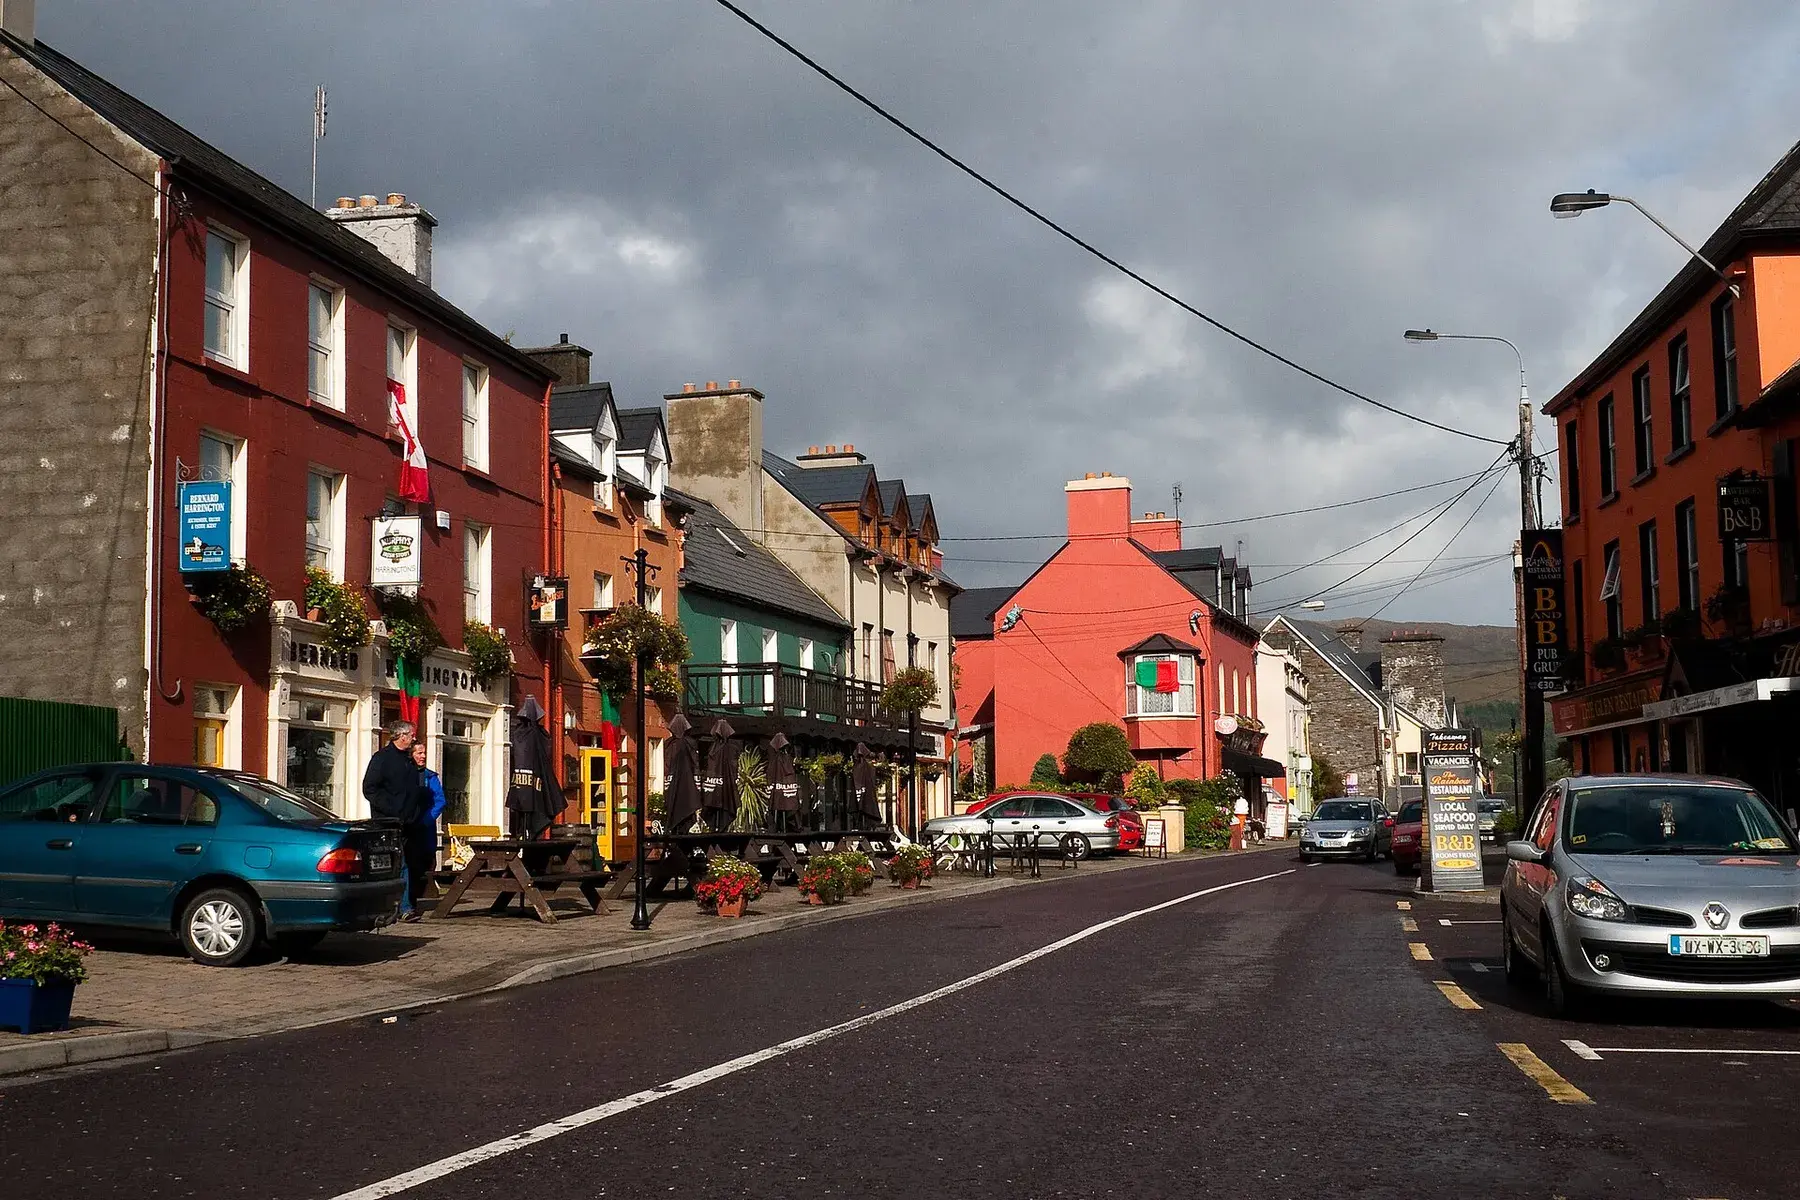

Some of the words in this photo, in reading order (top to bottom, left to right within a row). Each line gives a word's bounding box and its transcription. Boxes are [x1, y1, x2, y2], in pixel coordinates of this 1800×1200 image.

[190, 494, 219, 504] BERNARD
[184, 503, 225, 513] HARRINGTON
[1722, 507, 1762, 531] B&B
[1533, 587, 1557, 611] B
[1534, 620, 1558, 645] B
[1537, 648, 1558, 660] PUB
[1537, 681, 1554, 690] €30
[1430, 732, 1467, 741] Takeaway
[1428, 741, 1469, 750] Pizzas
[1428, 757, 1470, 765] VACANCIES
[1443, 770, 1457, 778] The
[1431, 776, 1471, 785] Rainbow
[1430, 786, 1473, 794] RESTAURANT
[1440, 802, 1467, 811] LOCAL
[1433, 812, 1476, 823] SEAFOOD
[1435, 834, 1476, 851] B&B
